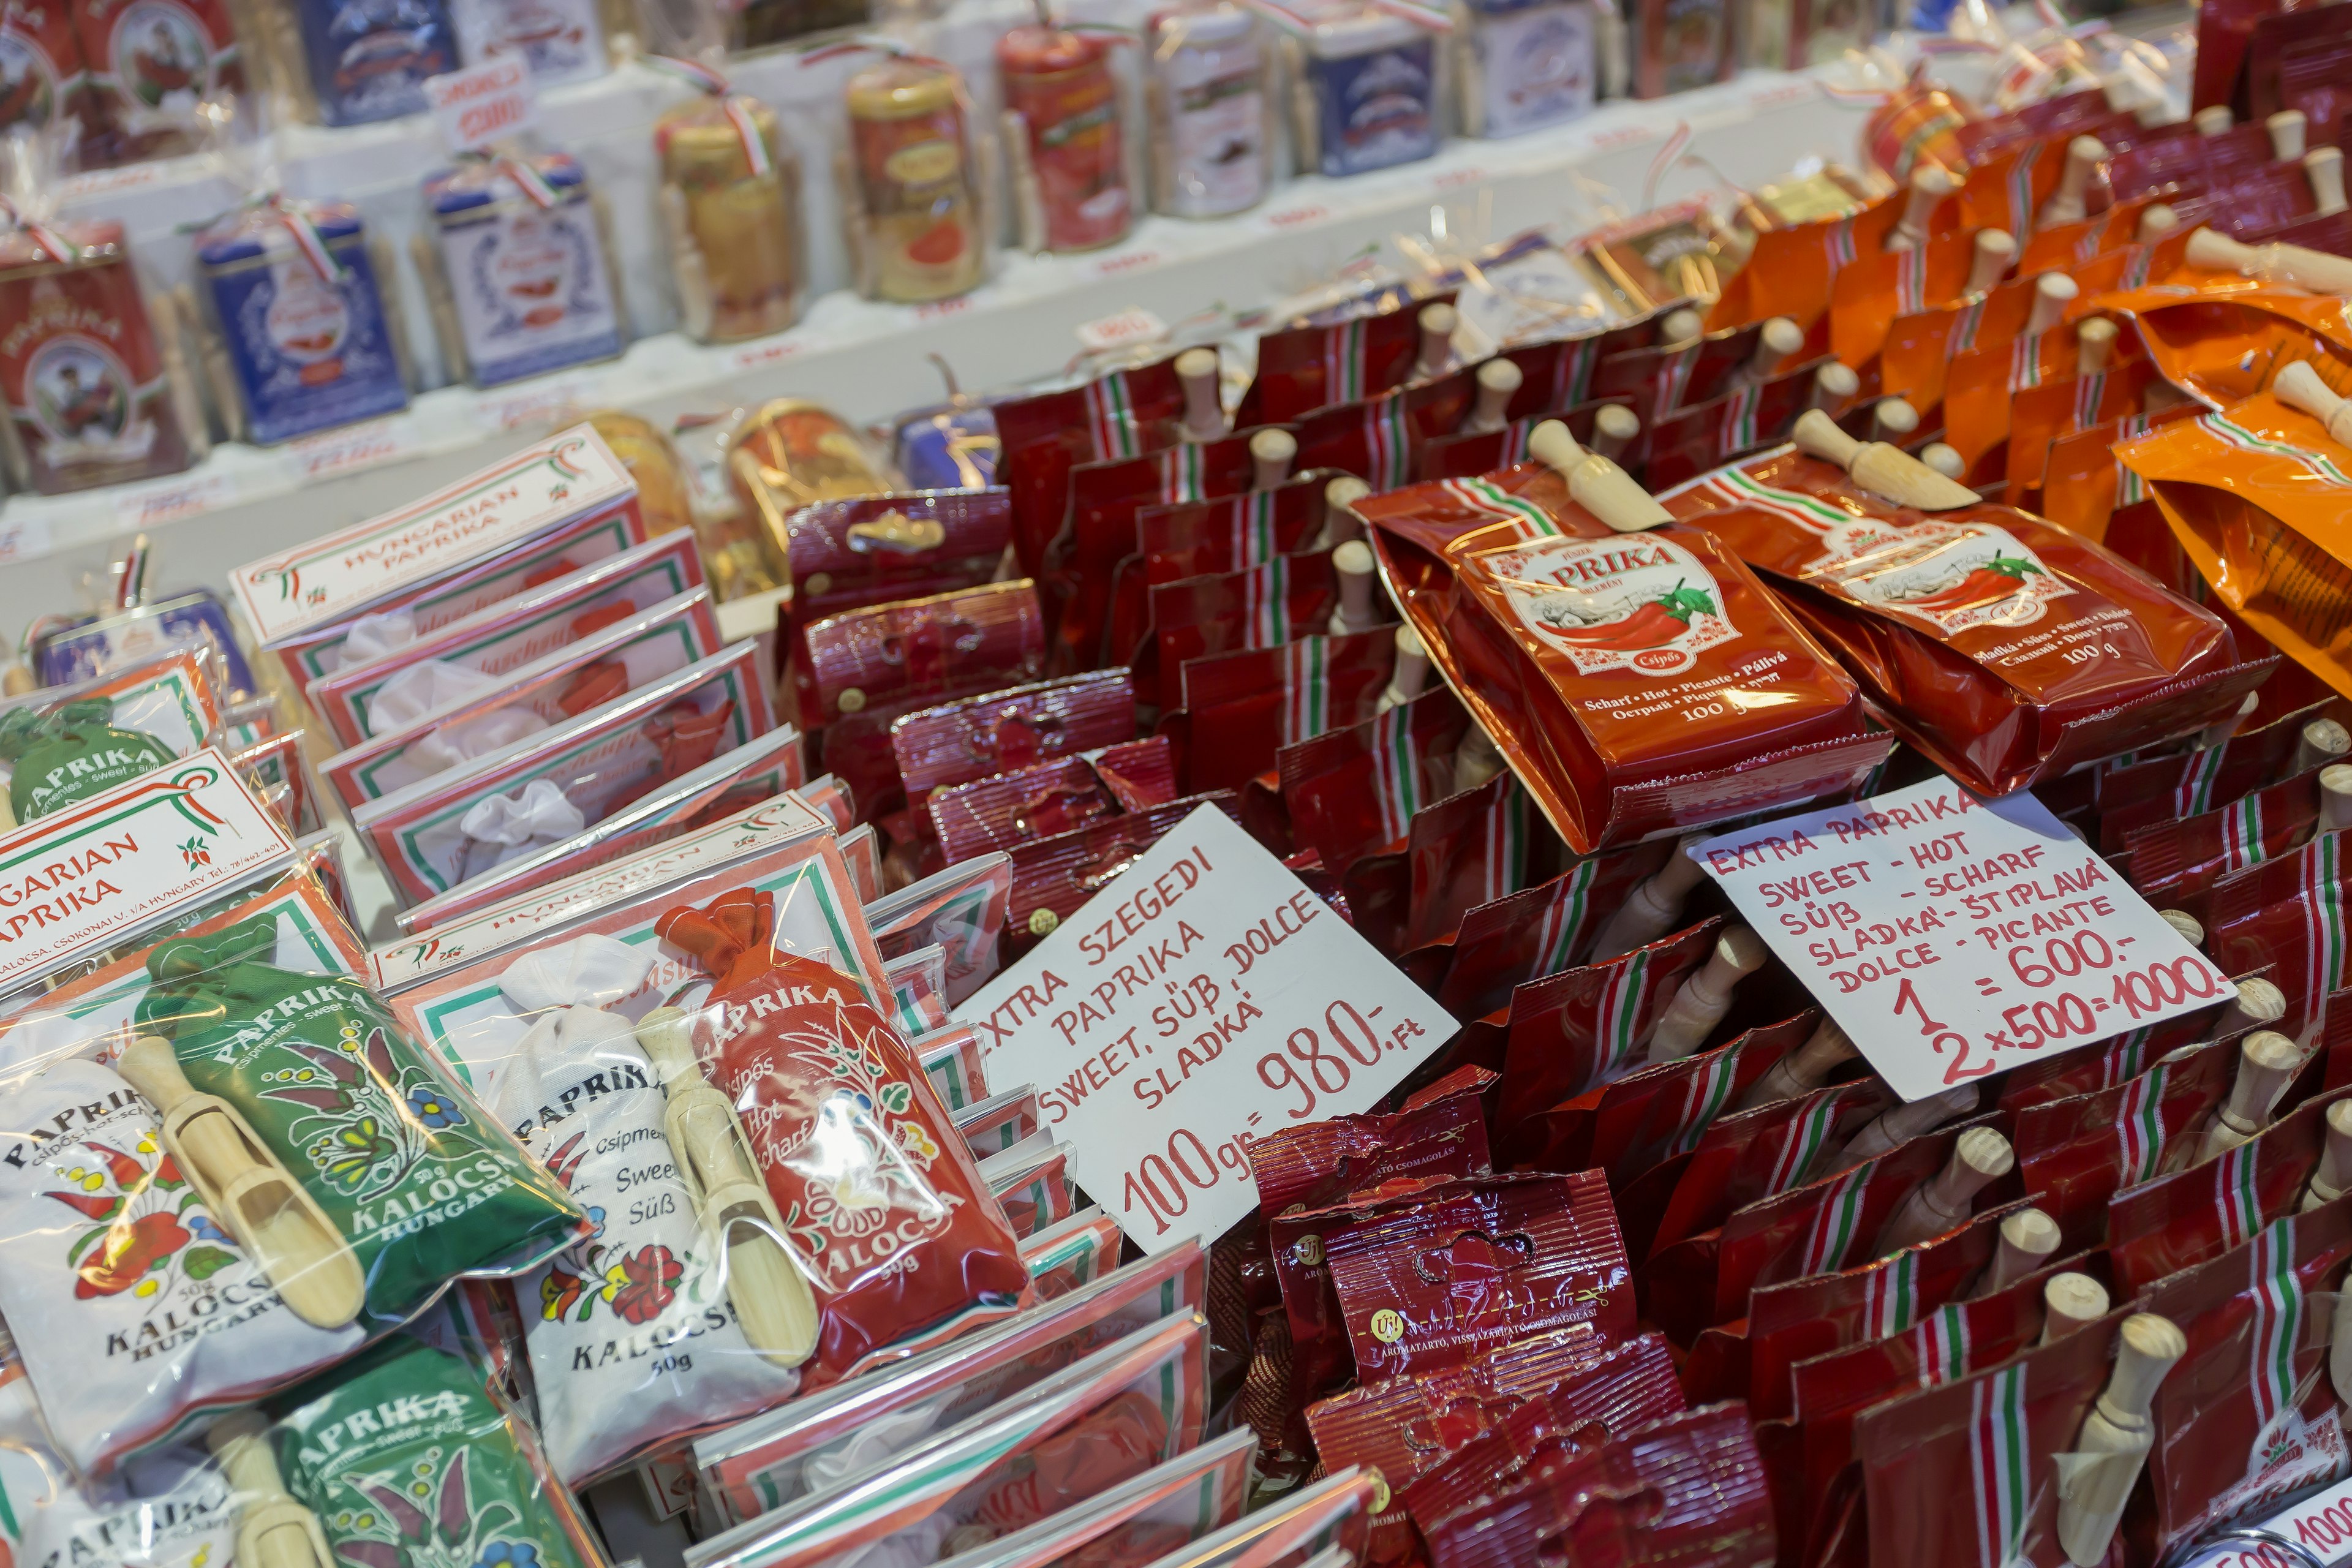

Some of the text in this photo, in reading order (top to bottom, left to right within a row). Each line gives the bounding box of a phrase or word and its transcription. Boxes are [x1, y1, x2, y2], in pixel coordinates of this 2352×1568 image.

[383, 516, 500, 570] PAPRIKA
[1973, 642, 2019, 662] Sladká
[2022, 631, 2052, 647] Süss
[2056, 616, 2094, 633] Sweet
[2060, 643, 2121, 665] 100 g
[2062, 627, 2098, 644] Doux
[1584, 650, 1789, 711] Scharf Hot Picante Pálivá
[1612, 700, 1673, 720] Острый
[1681, 703, 1724, 722] 100
[91, 766, 127, 783] sweet
[1706, 787, 1986, 876] EXTRA PAPRIKA
[1758, 860, 1871, 908] SWEET
[1909, 831, 1972, 872] HOT
[1923, 844, 2046, 898] SCHARF
[53, 918, 113, 949] CSOKONAI
[149, 875, 205, 905] HUNGARY
[1224, 888, 1322, 976] DOLCE
[980, 845, 1213, 1057] XTRA SZEGEDI
[1828, 942, 1942, 995] DOLCE
[1974, 895, 2116, 951] PICANTE
[304, 1001, 345, 1020] sweet
[1050, 920, 1205, 1047] PAPRIKA
[1893, 978, 1949, 1037] 1
[213, 985, 371, 1065] PAPRIKA
[3, 1088, 143, 1170] PAPRIK
[747, 1098, 782, 1136] Hot
[1395, 1146, 1456, 1170] CSOMAGOLÁS!
[352, 1153, 519, 1235] KALOCSA
[380, 1174, 516, 1242] HUNGARY
[629, 1193, 676, 1225] Süß
[812, 1191, 966, 1278] ALOCSA
[1376, 1313, 1399, 1338] Új!
